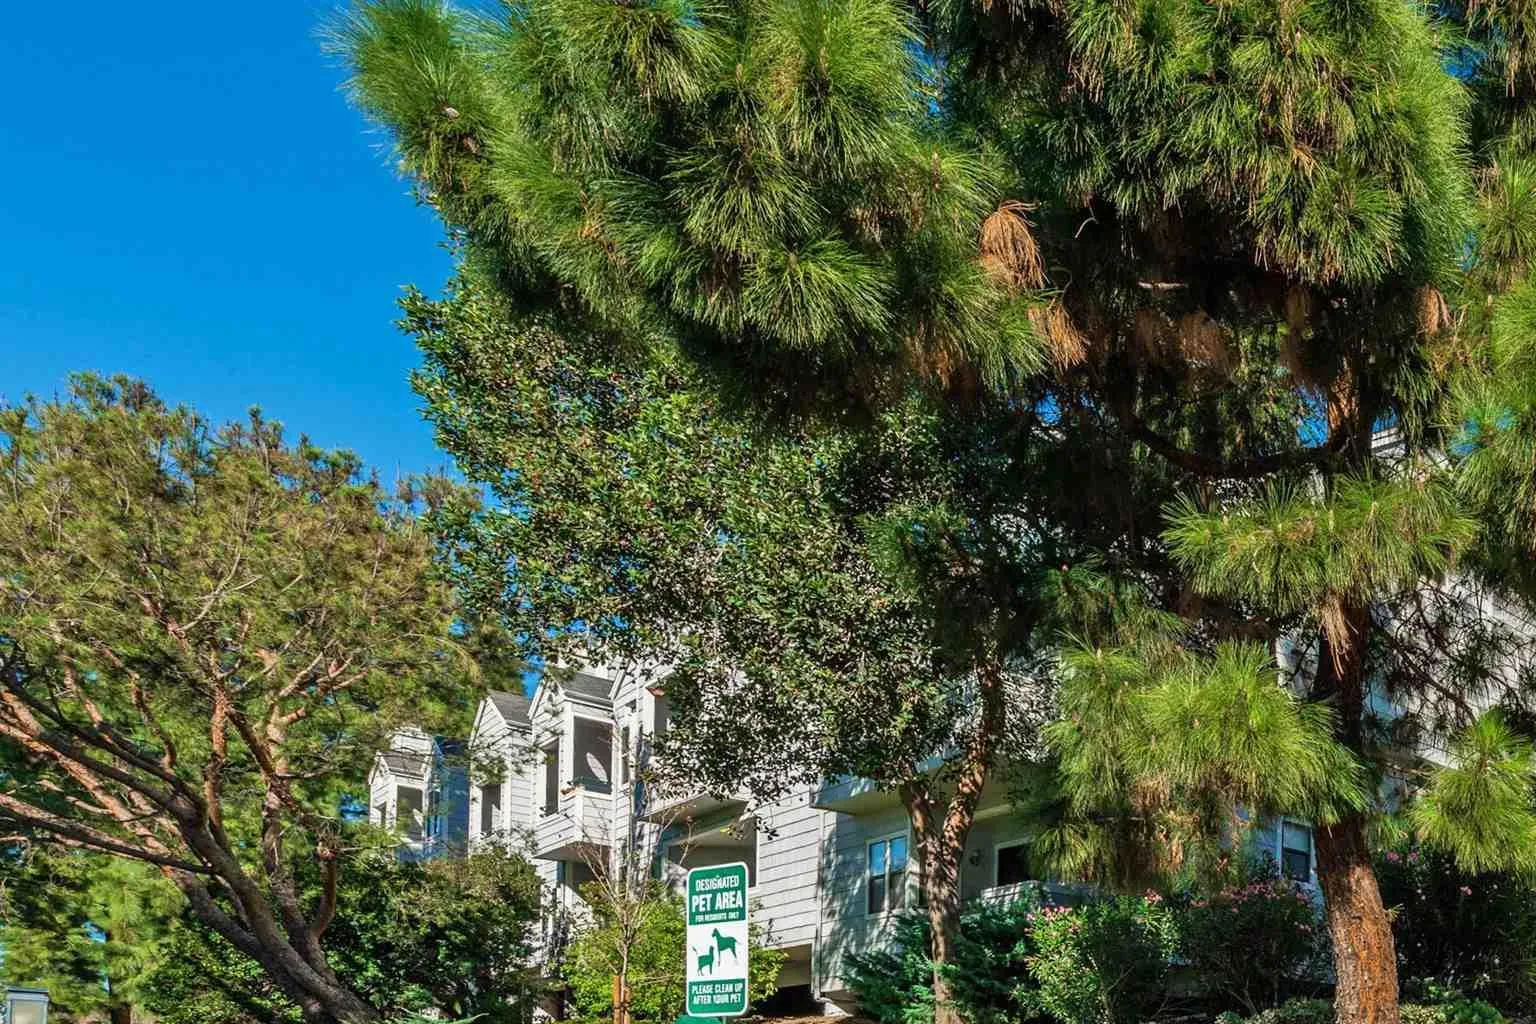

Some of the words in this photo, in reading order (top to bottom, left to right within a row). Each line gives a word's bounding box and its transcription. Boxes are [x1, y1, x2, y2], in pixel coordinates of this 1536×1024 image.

[696, 875, 739, 891] DESIGNATED
[692, 894, 712, 912] PET
[715, 890, 743, 910] AREA
[692, 984, 713, 994] PLEASE
[714, 983, 733, 993] CLEAN
[735, 983, 743, 992] UP
[693, 995, 712, 1004] AFTER
[713, 994, 729, 1004] YOUR
[730, 993, 741, 1003] PET
